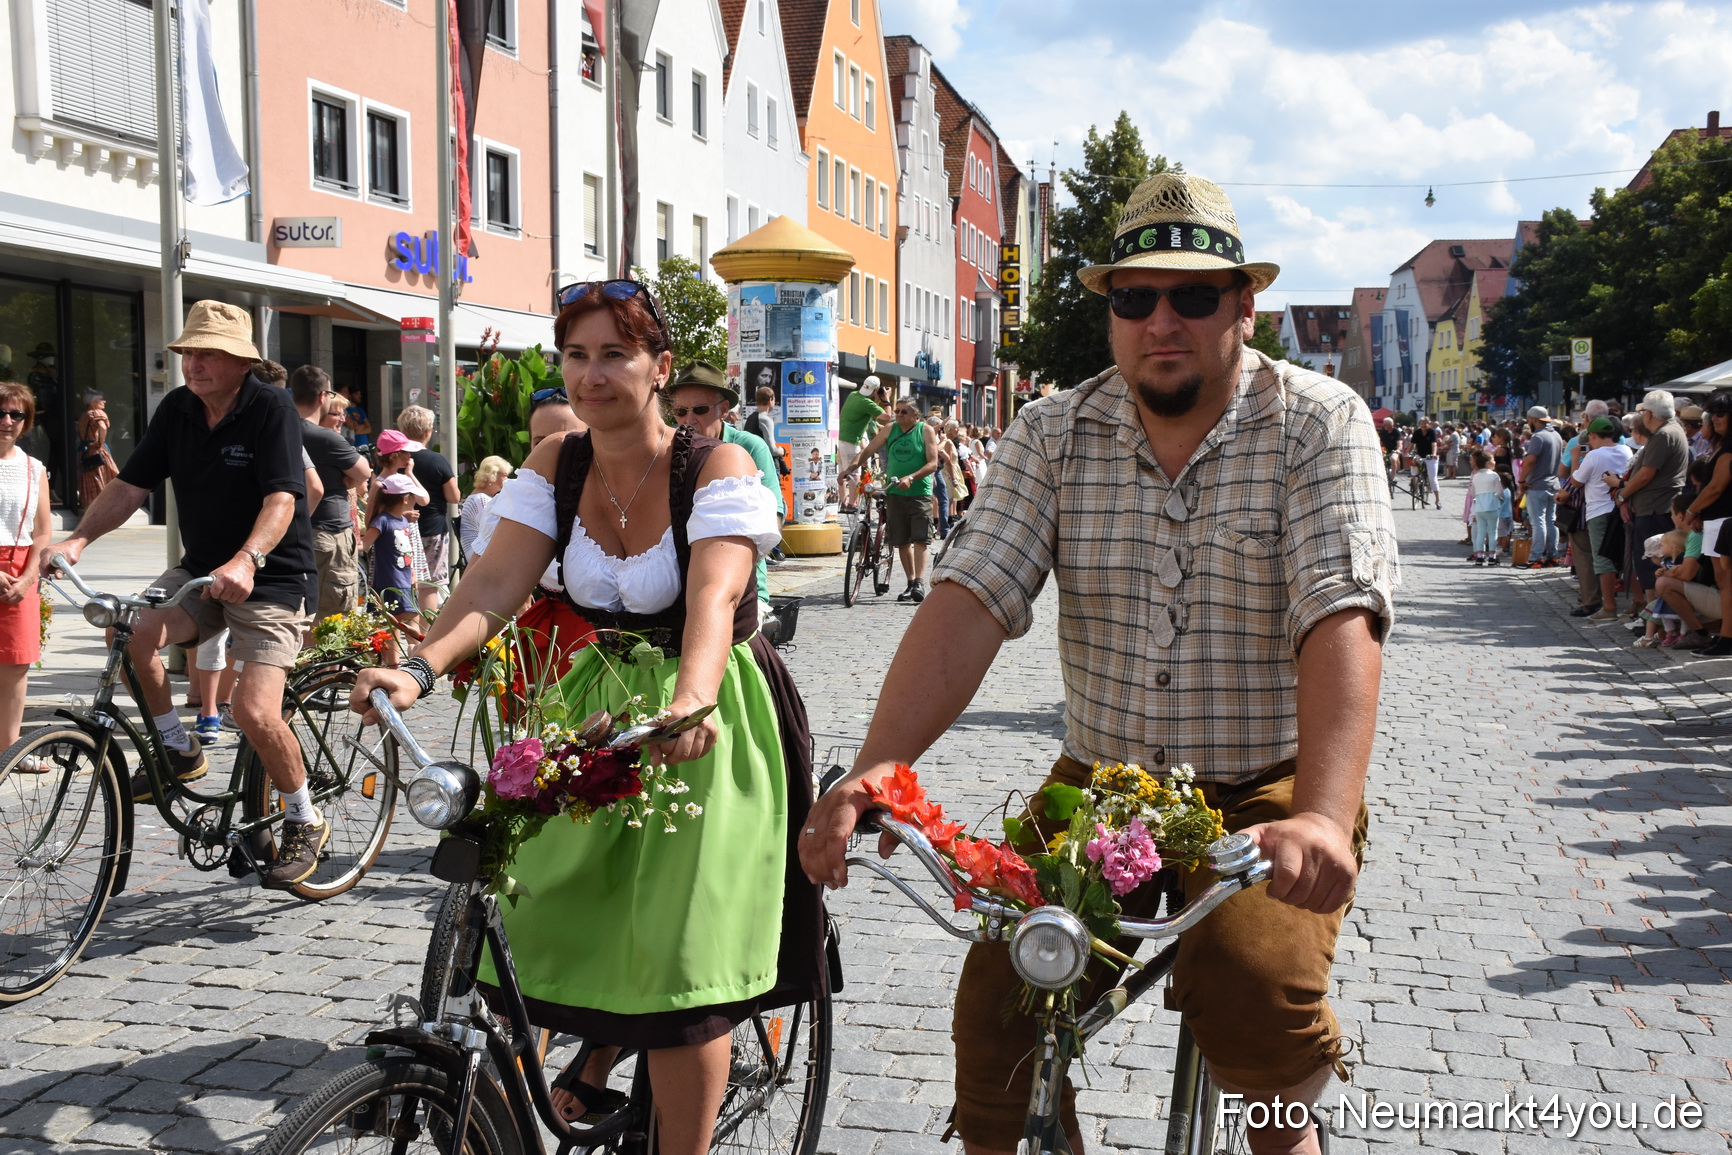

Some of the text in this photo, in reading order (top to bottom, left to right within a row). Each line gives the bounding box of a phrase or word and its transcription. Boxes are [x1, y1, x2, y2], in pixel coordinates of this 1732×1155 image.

[276, 222, 334, 241] sutor.
[1170, 226, 1182, 248] now
[1002, 247, 1019, 346] HOTEL
[788, 371, 815, 385] G6
